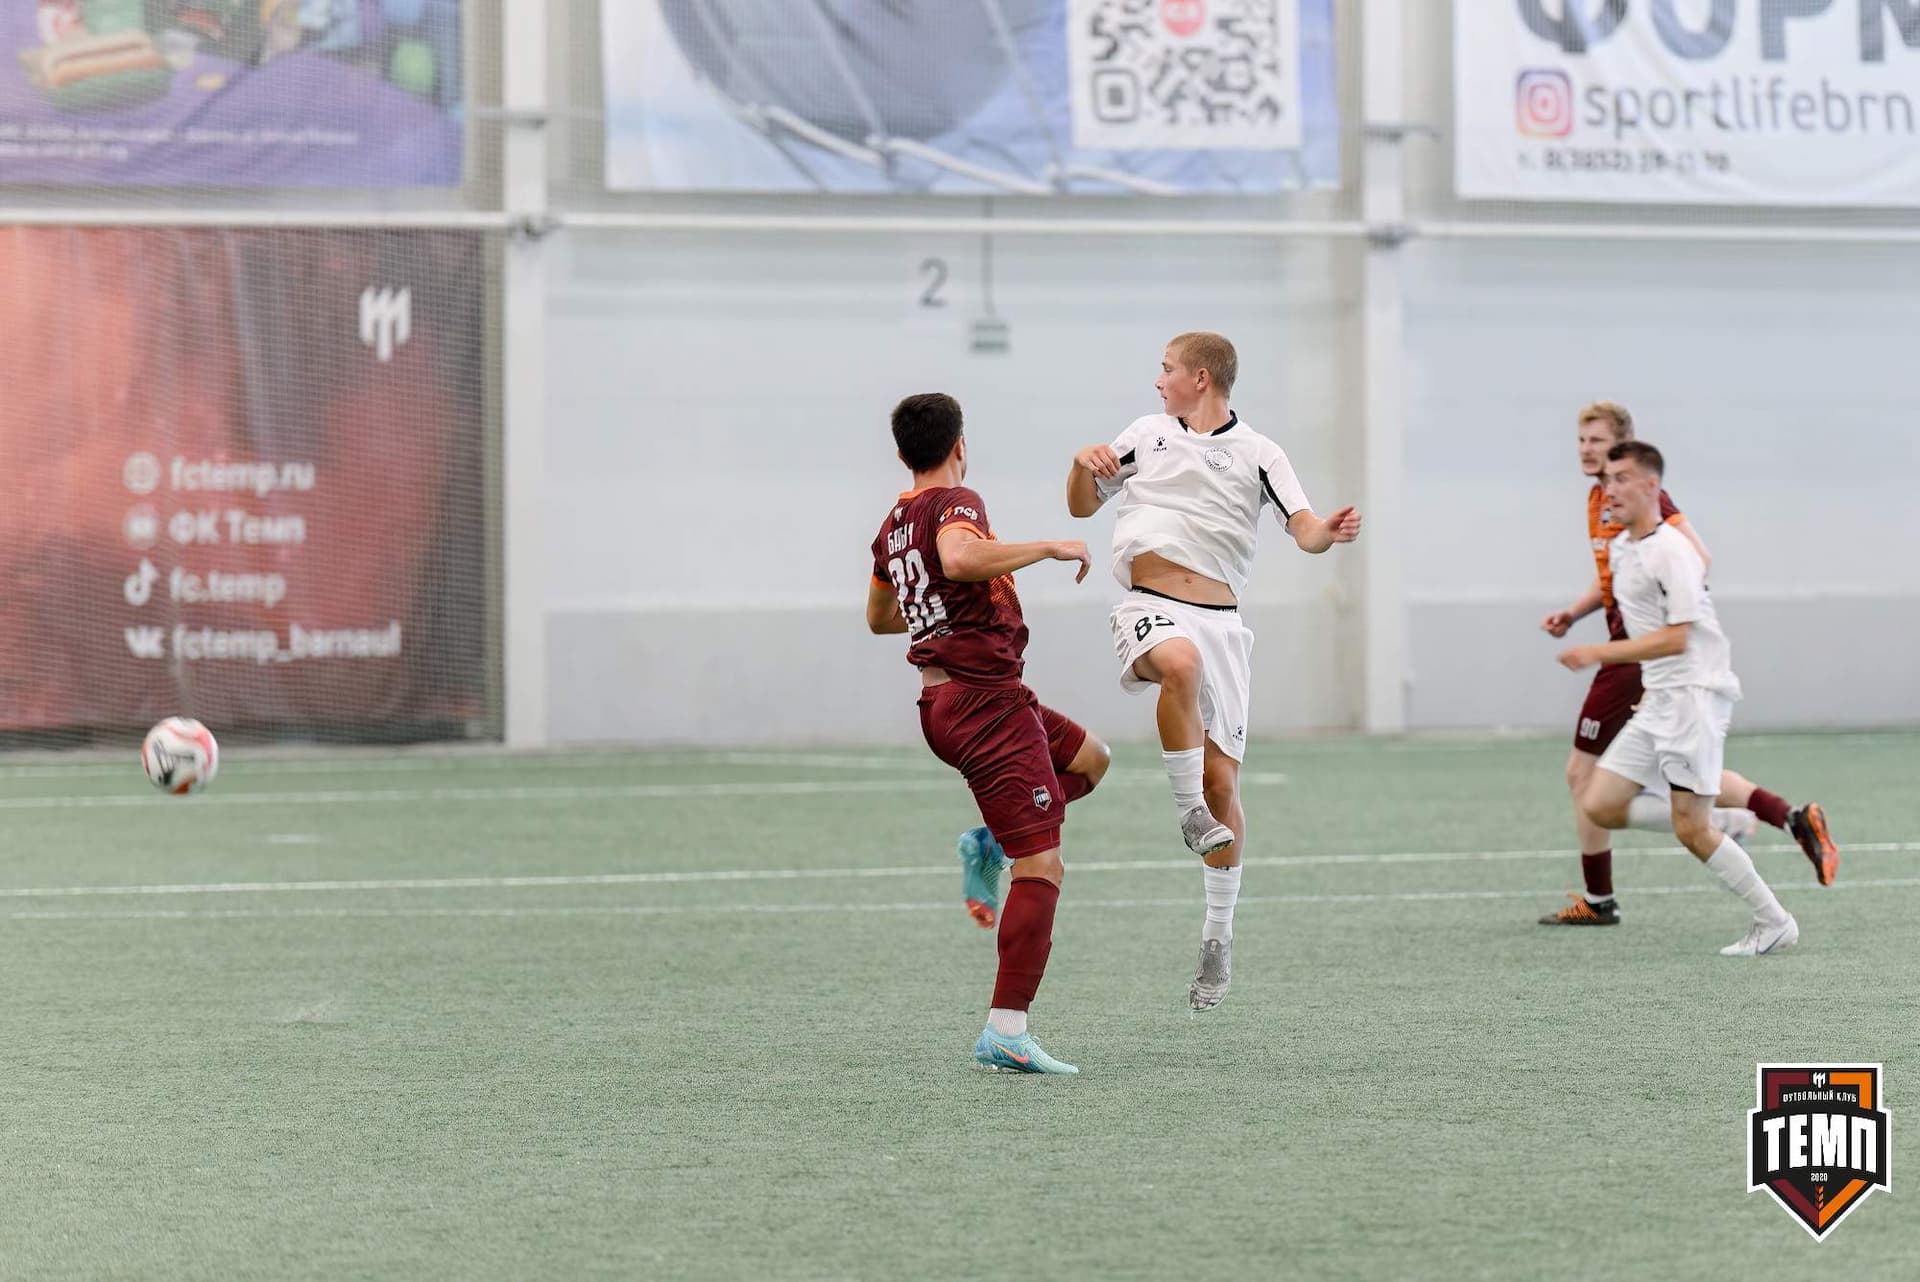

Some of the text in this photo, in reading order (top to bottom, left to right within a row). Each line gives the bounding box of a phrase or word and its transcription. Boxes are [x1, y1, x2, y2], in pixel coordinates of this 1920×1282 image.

[1584, 76, 1915, 140] sportlifebrn
[918, 256, 949, 308] 2
[170, 455, 316, 498] fctemp.ru
[168, 509, 307, 545] ФК Темп
[169, 566, 287, 608] fc.temp
[171, 619, 401, 666] fctemp_barnaul
[1580, 717, 1601, 740] 90
